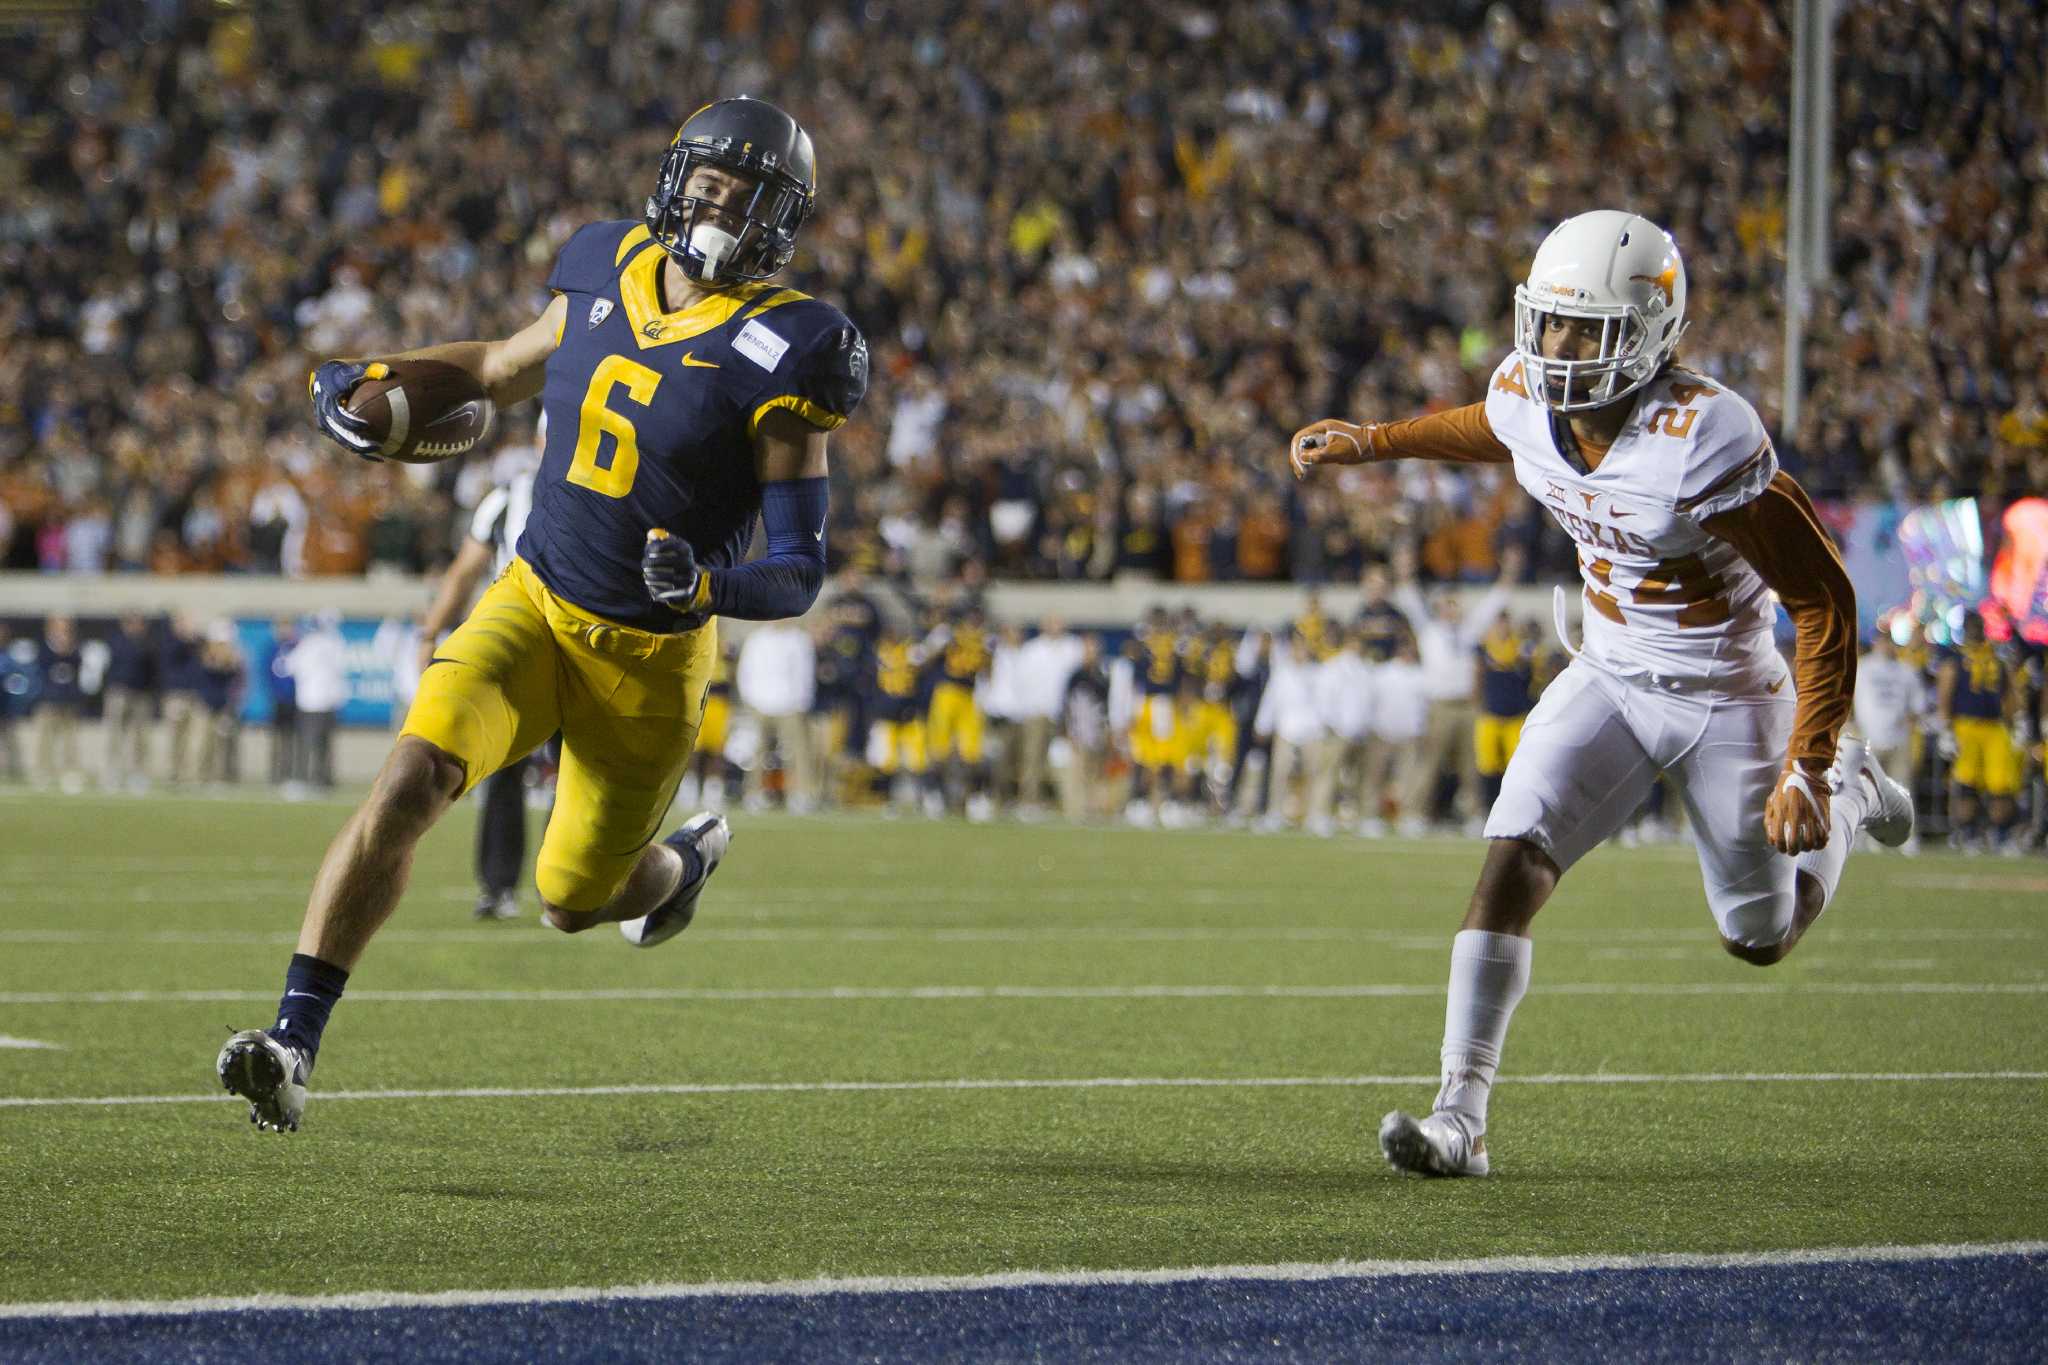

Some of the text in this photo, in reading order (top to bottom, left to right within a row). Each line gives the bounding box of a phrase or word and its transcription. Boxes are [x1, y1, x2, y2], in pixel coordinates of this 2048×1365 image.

[640, 320, 668, 340] Cal
[566, 354, 663, 499] 6
[1548, 504, 1657, 559] TEXAS
